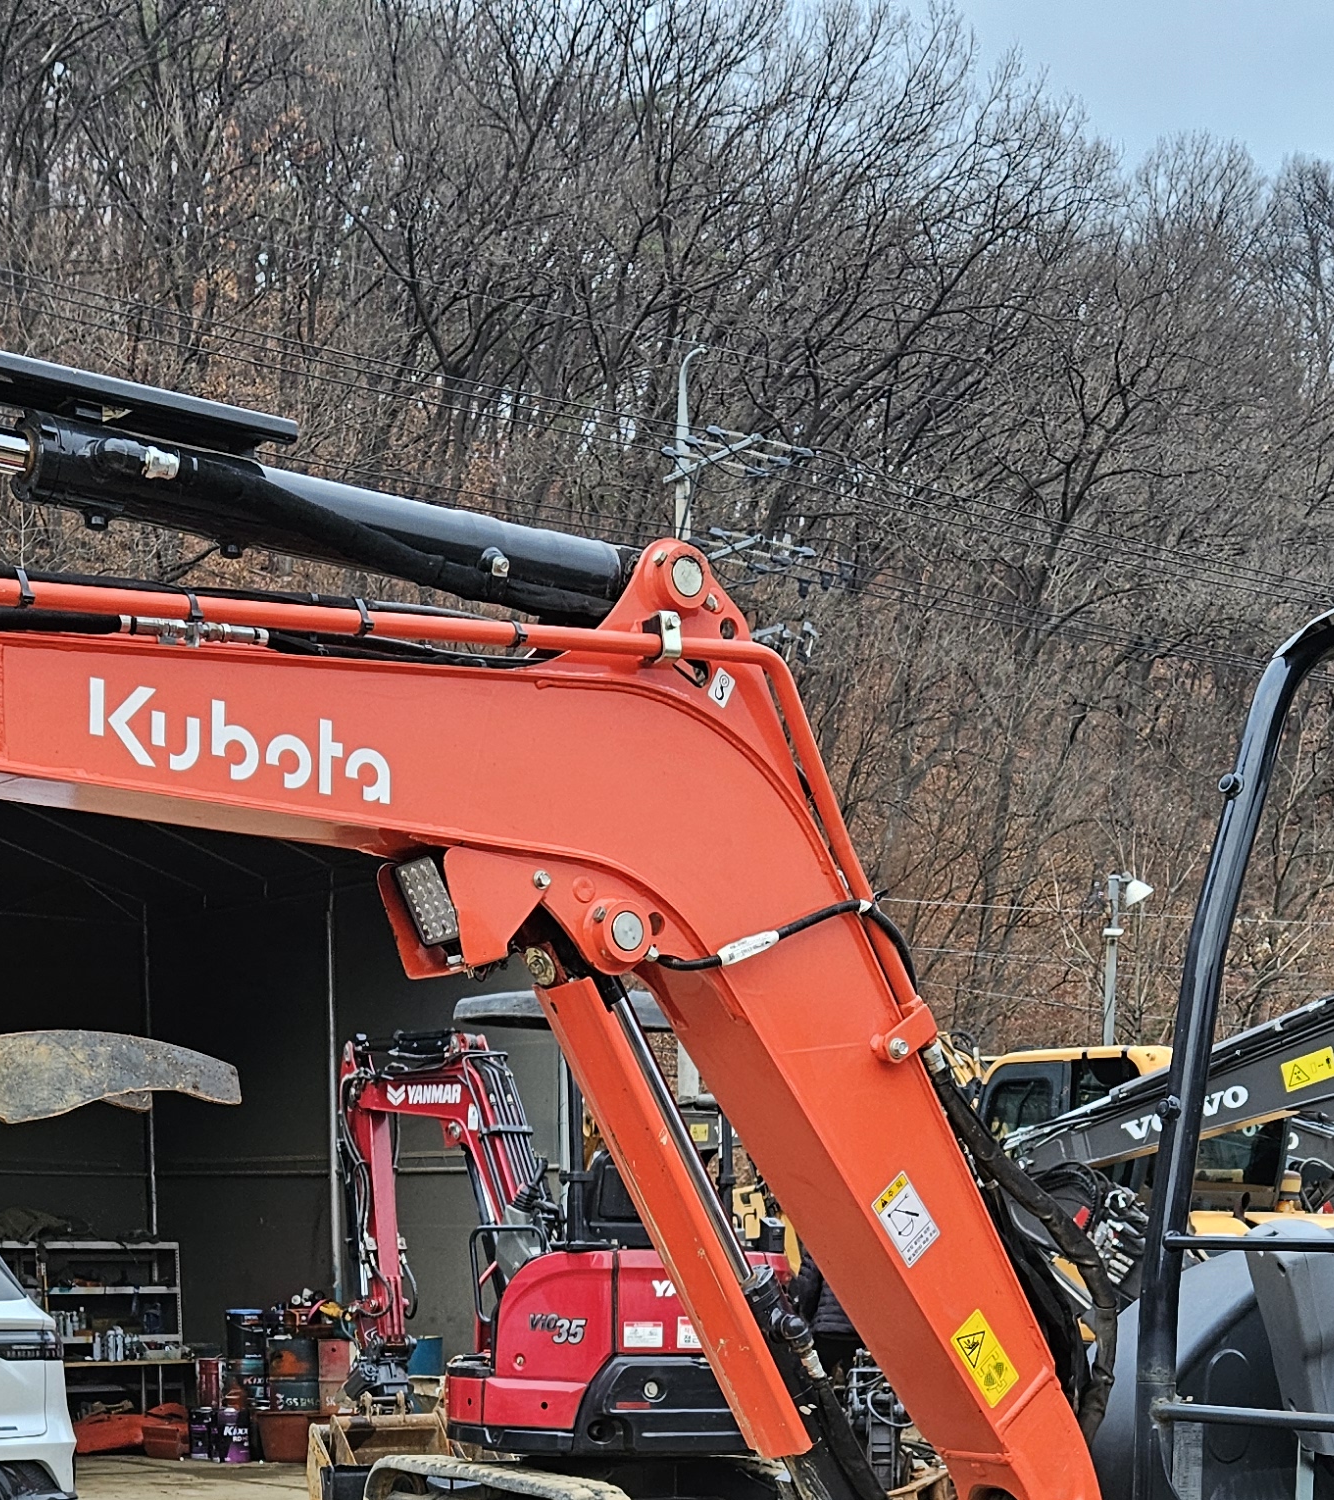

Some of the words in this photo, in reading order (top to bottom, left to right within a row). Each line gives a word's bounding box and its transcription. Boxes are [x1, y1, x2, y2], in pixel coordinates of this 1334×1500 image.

[89, 676, 391, 805] Kubota
[407, 1083, 462, 1105] YANMAR
[223, 1425, 249, 1436] Kixx
